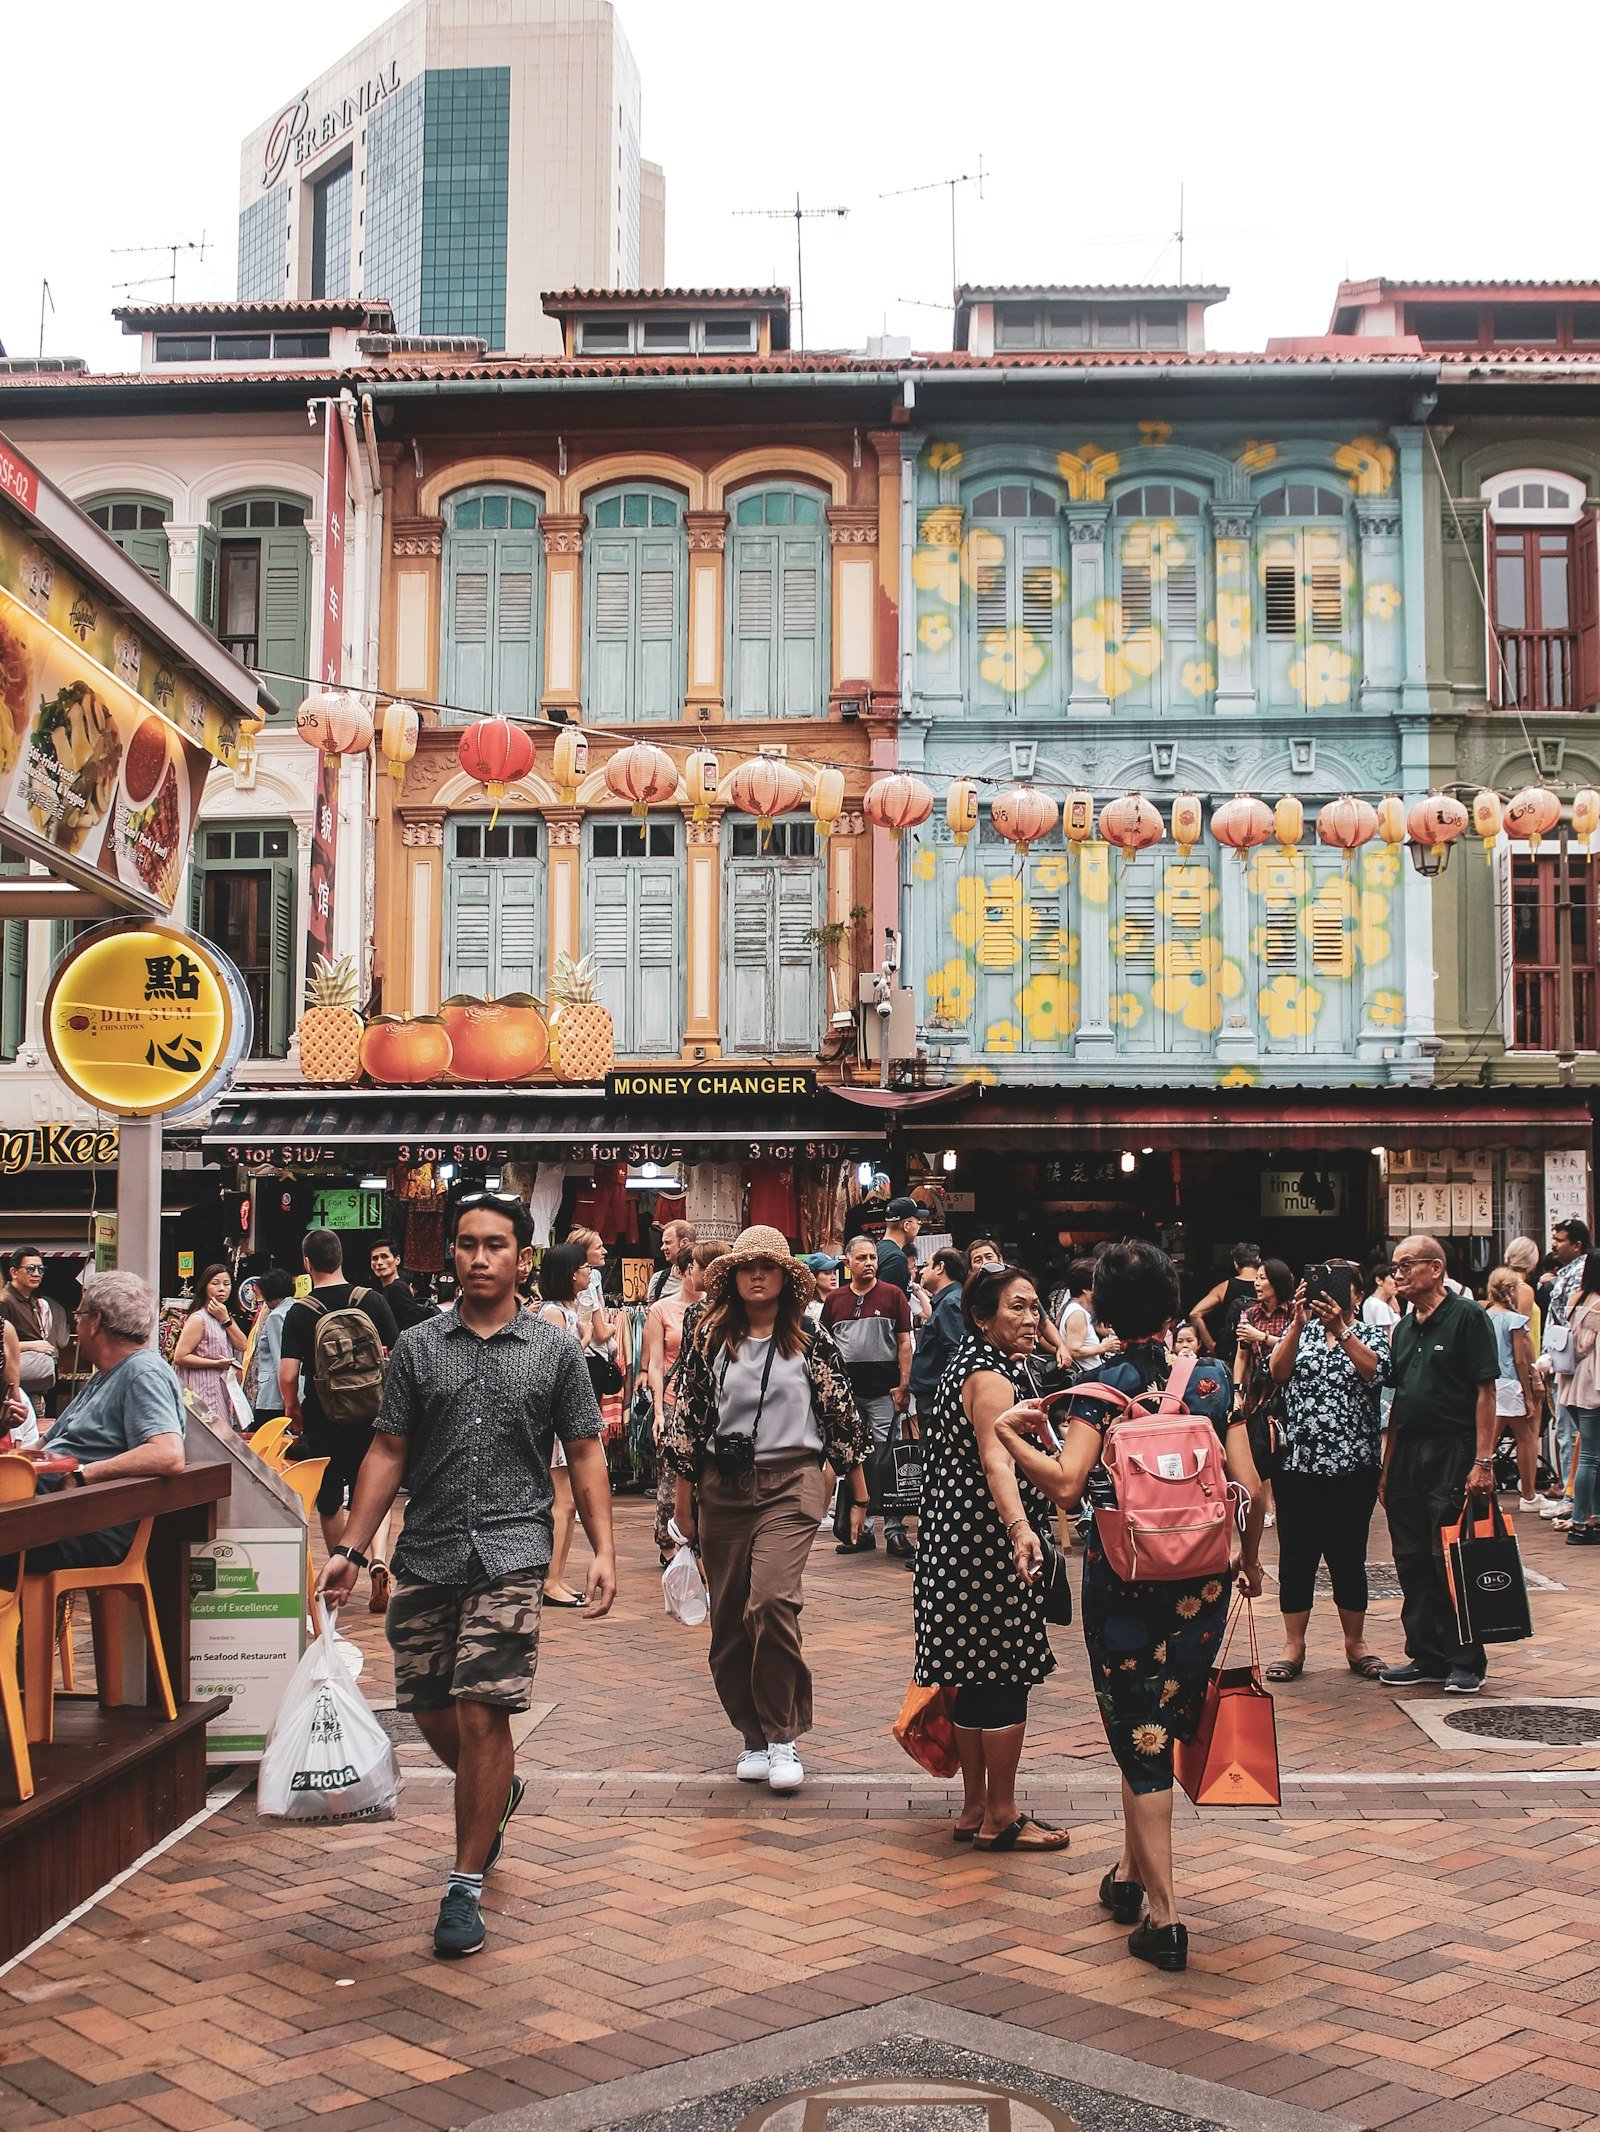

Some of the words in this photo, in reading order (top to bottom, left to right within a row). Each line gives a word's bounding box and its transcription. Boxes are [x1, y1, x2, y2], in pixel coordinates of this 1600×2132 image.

[57, 762, 74, 782] Fresh
[24, 761, 58, 791] Mushroom
[63, 785, 87, 809] Veggies
[139, 832, 153, 849] Pork
[101, 1008, 141, 1022] DIM
[149, 1006, 192, 1021] SUM
[614, 1077, 692, 1095] MONEY
[697, 1077, 807, 1094] CHANGER
[38, 1124, 118, 1164] Kee
[591, 1143, 620, 1160] for
[749, 1143, 761, 1159] 3
[245, 1146, 275, 1162] for
[398, 1145, 410, 1162] 3
[417, 1144, 447, 1162] for
[954, 1194, 964, 1202] ST
[347, 1192, 381, 1227] $10
[624, 1263, 634, 1299] 5
[219, 1574, 247, 1582] Winner
[217, 1603, 227, 1613] of
[229, 1602, 279, 1612] Excellence
[204, 1652, 238, 1661] Seafood
[241, 1652, 287, 1660] Restaurant
[309, 1766, 358, 1788] HOUR
[333, 1804, 381, 1820] CENTRE
